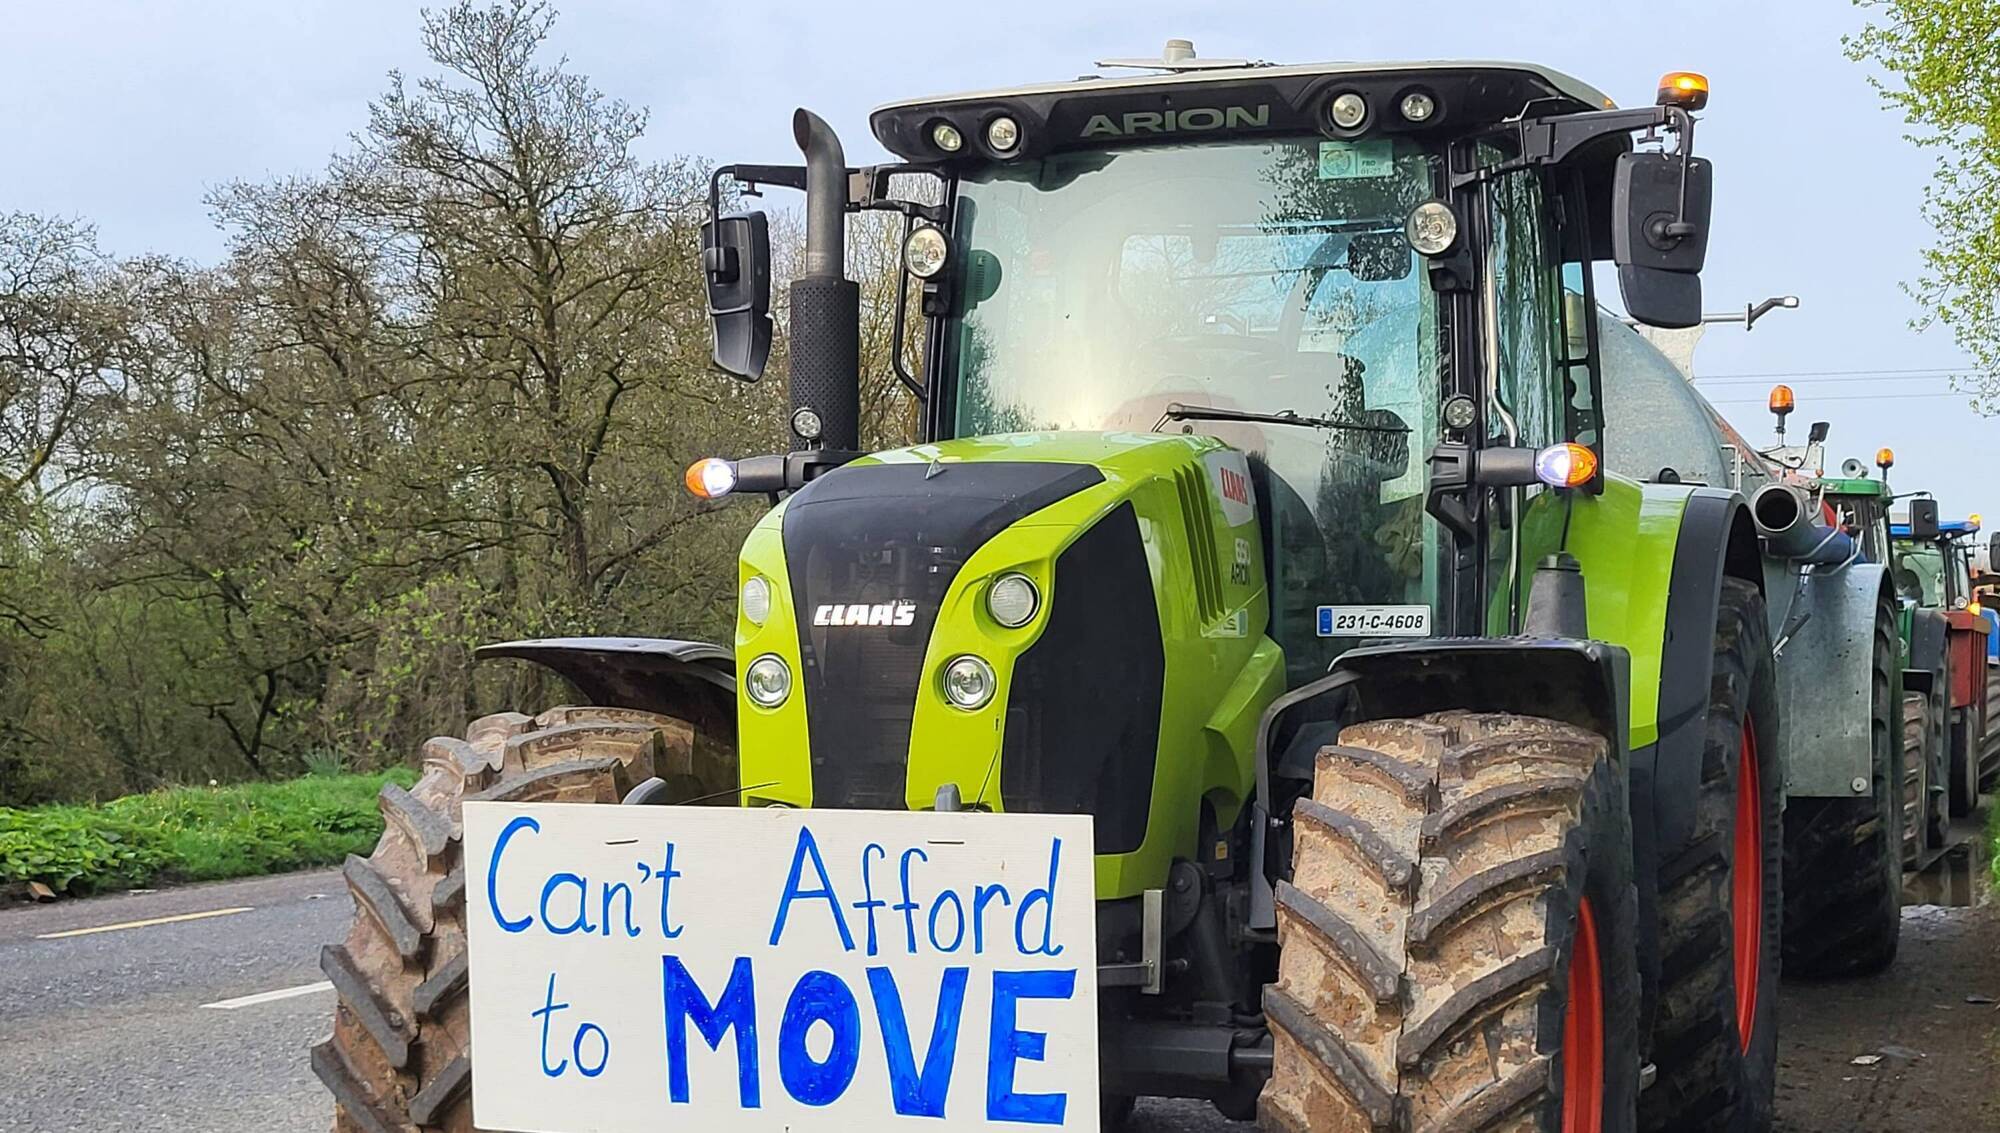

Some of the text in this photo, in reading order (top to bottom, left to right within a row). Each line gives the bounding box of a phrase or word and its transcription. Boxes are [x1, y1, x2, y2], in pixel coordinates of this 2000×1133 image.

[1080, 104, 1270, 138] ARION
[813, 603, 917, 627] CLAAS
[1336, 614, 1424, 630] 231-C-4608
[486, 816, 1064, 956] Can't Afford
[531, 953, 1078, 1126] to MOVE
